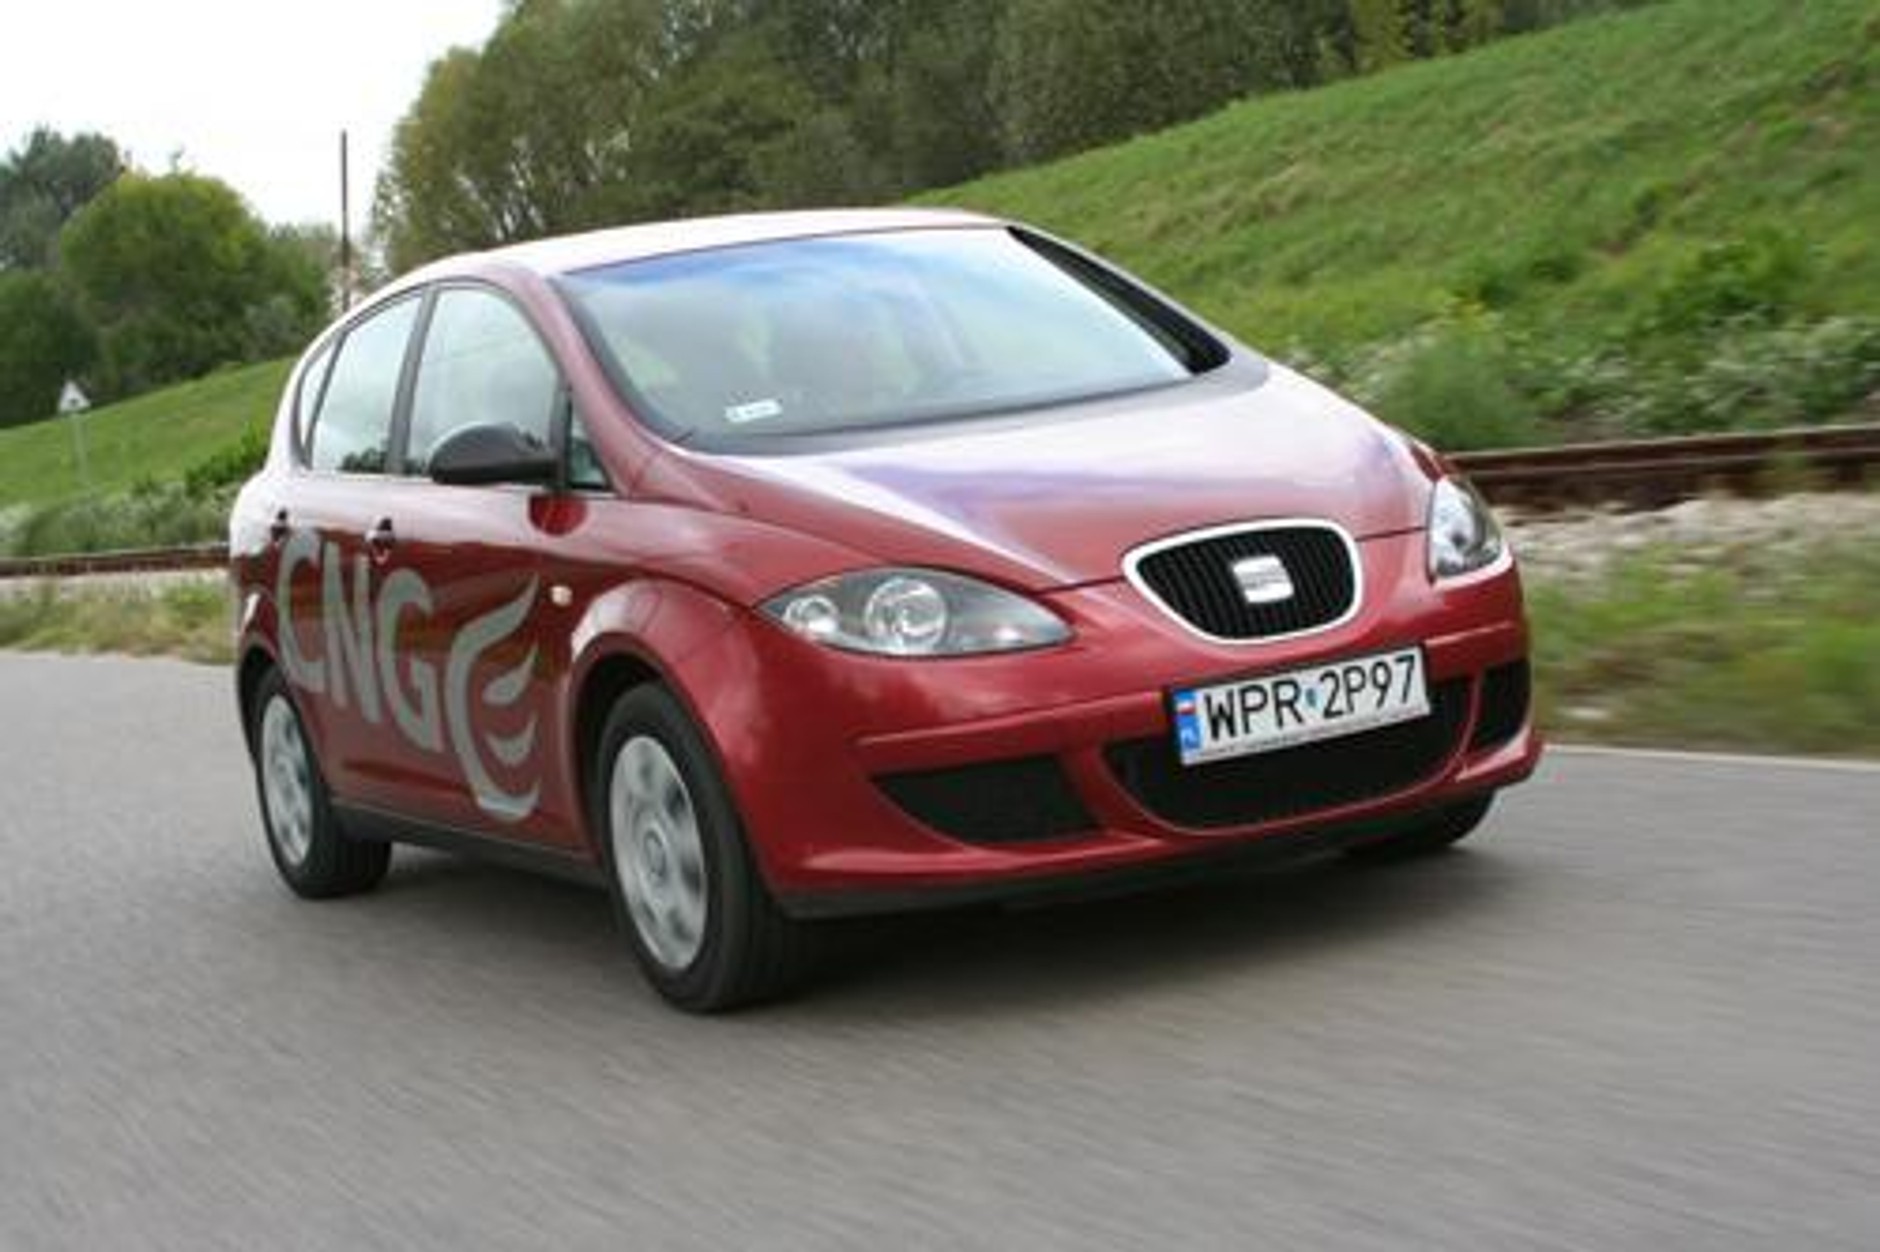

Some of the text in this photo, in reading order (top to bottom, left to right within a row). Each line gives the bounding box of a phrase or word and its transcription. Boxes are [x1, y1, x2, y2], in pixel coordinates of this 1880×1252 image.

[277, 527, 444, 752] CNG
[1204, 654, 1416, 741] WPR 2P97
